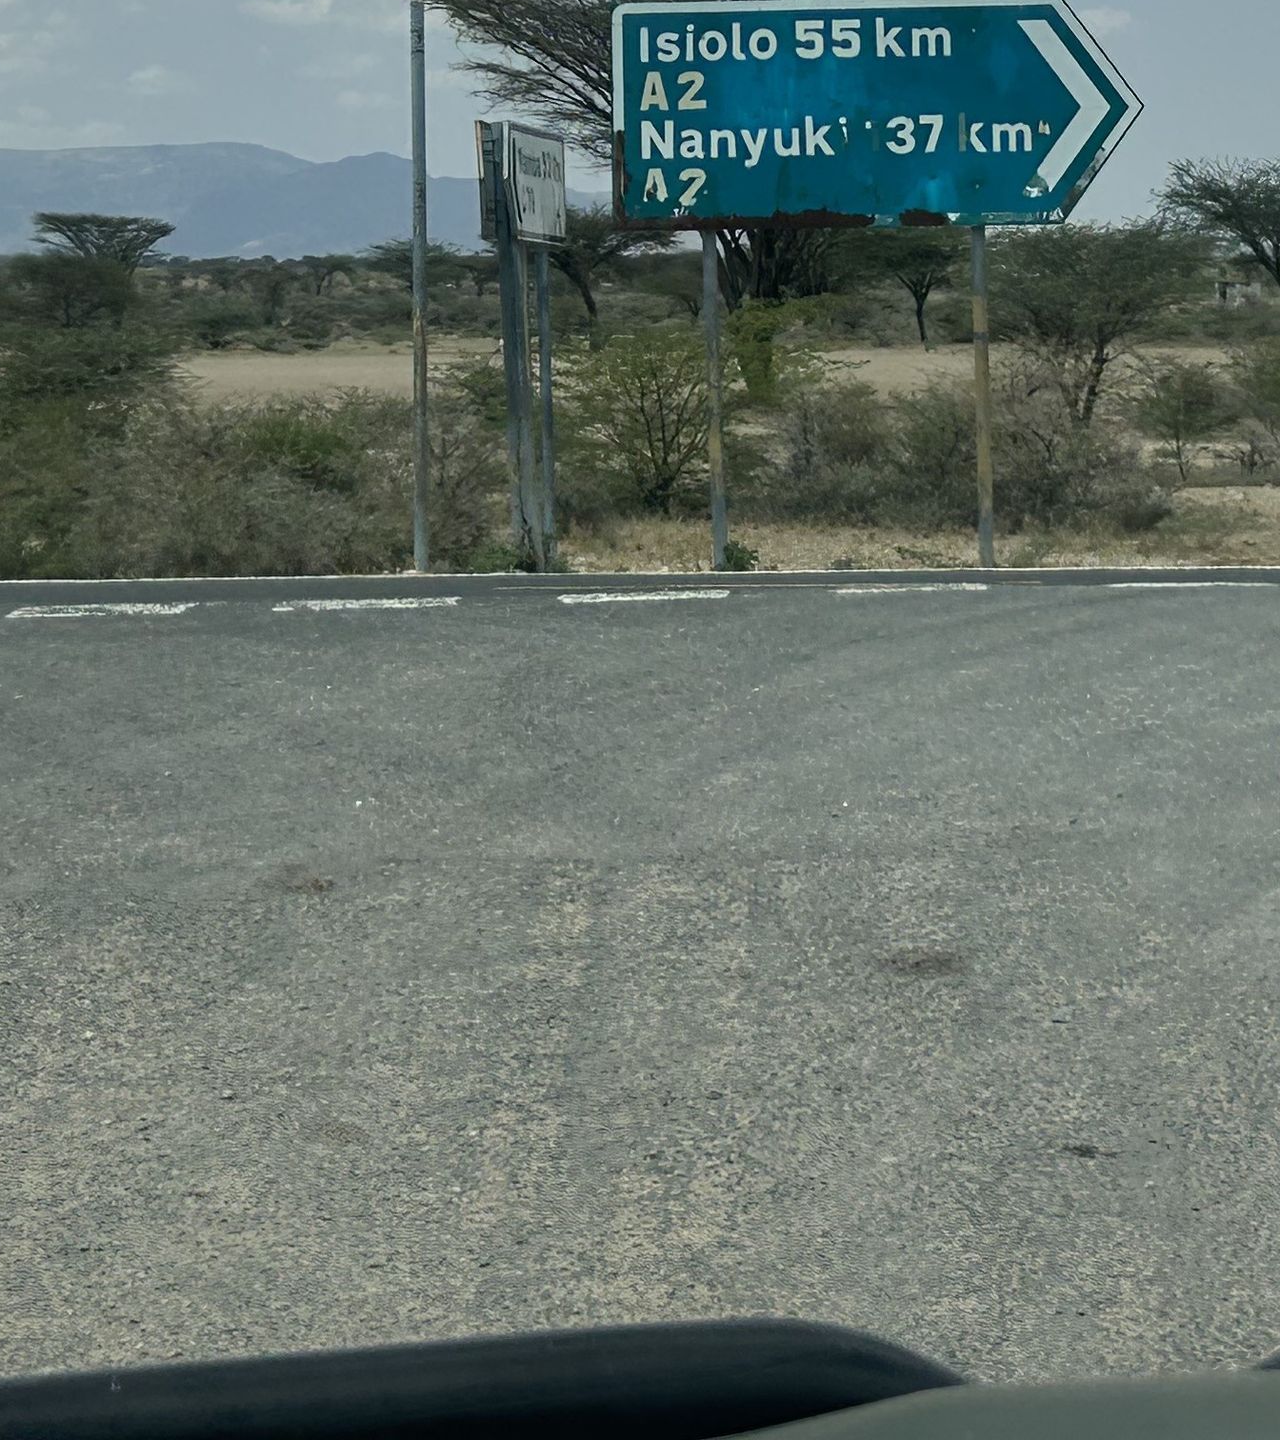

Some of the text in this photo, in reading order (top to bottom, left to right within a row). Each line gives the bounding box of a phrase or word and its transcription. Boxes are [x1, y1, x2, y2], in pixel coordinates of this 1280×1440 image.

[639, 16, 952, 63] Isiolo 55 km
[639, 70, 708, 111] A2
[958, 112, 1033, 153] km
[642, 167, 708, 207] A2
